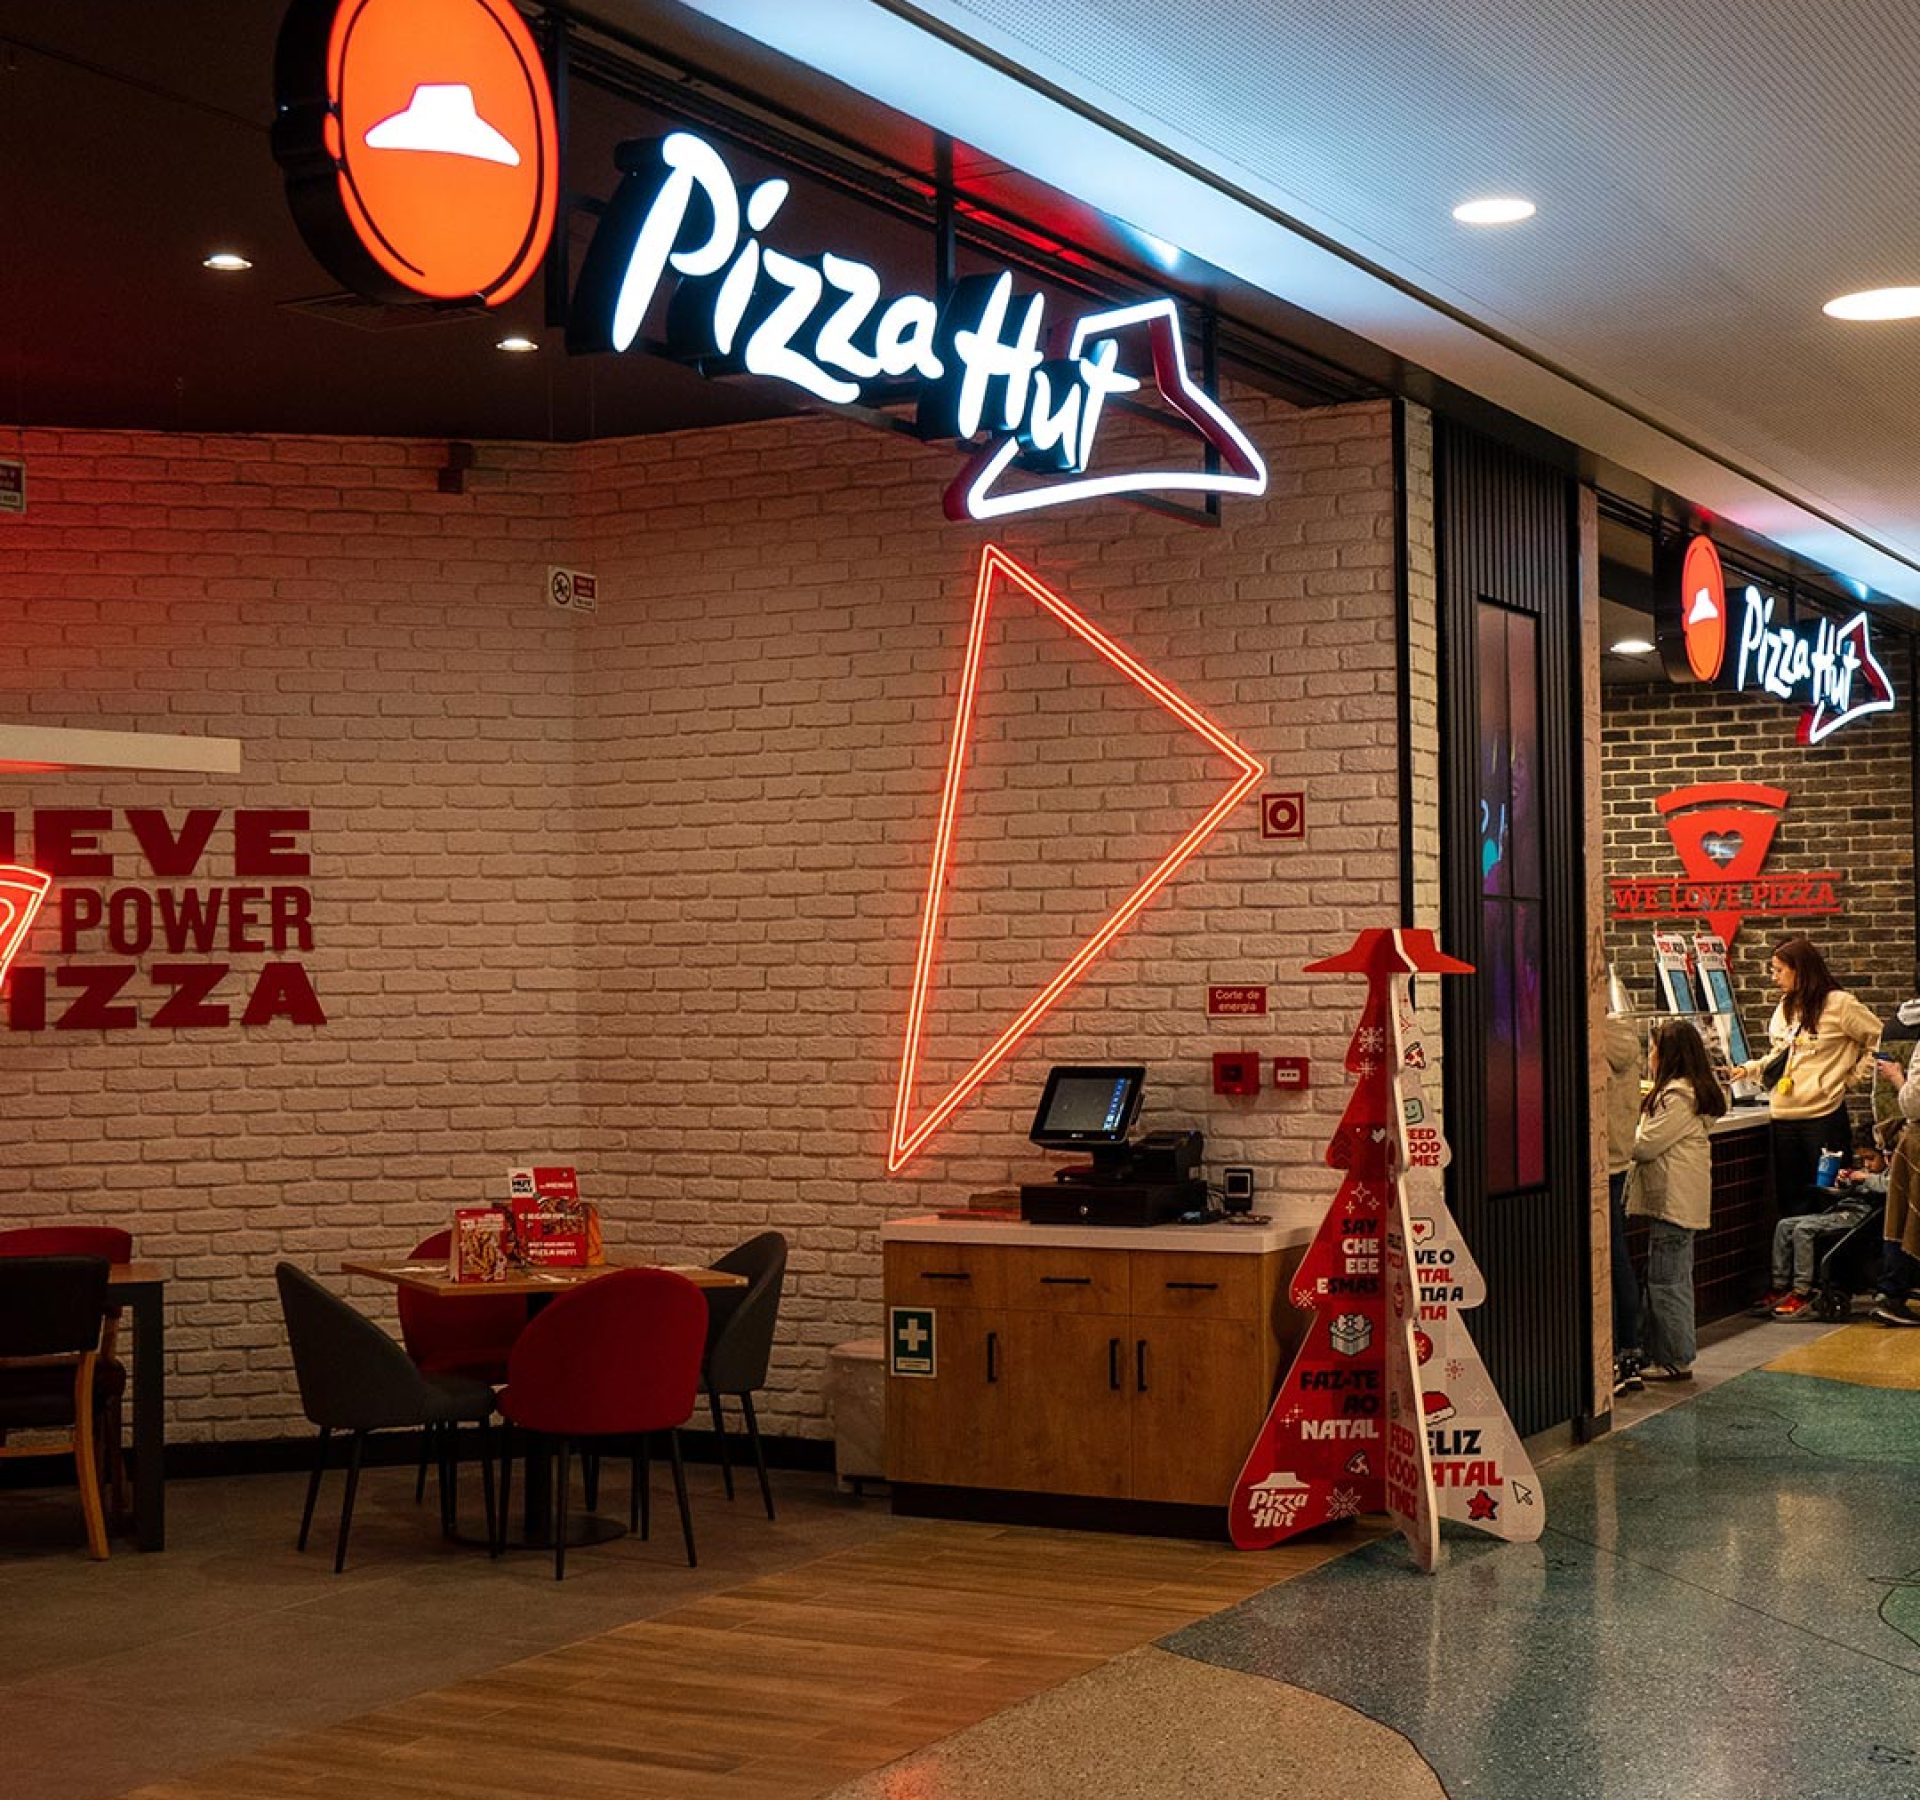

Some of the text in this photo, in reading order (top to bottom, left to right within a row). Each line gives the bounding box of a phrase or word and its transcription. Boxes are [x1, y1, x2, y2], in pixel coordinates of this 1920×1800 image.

[612, 132, 1139, 472] Pizza Hut
[1737, 585, 1862, 712] Pizza Hut
[1614, 882, 1837, 909] WE LOVE PIZZA
[60, 886, 314, 955] POWER
[9, 962, 327, 1031] IZZA
[1215, 989, 1260, 1000] Corte de
[1219, 1002, 1257, 1013] energia
[1408, 1141, 1441, 1153] OOD
[1342, 1218, 1378, 1234] SAY
[1342, 1238, 1379, 1255] CHE
[1415, 1250, 1455, 1265] VE O
[1345, 1258, 1379, 1275] EEE
[1300, 1369, 1379, 1391] FAZ-TE
[1343, 1393, 1379, 1415] AO
[1301, 1418, 1379, 1440] NATAL
[1428, 1429, 1481, 1455] LIZ
[1432, 1461, 1503, 1487] ATAL
[1248, 1489, 1309, 1513] Pizza
[1252, 1508, 1296, 1528] Hut
